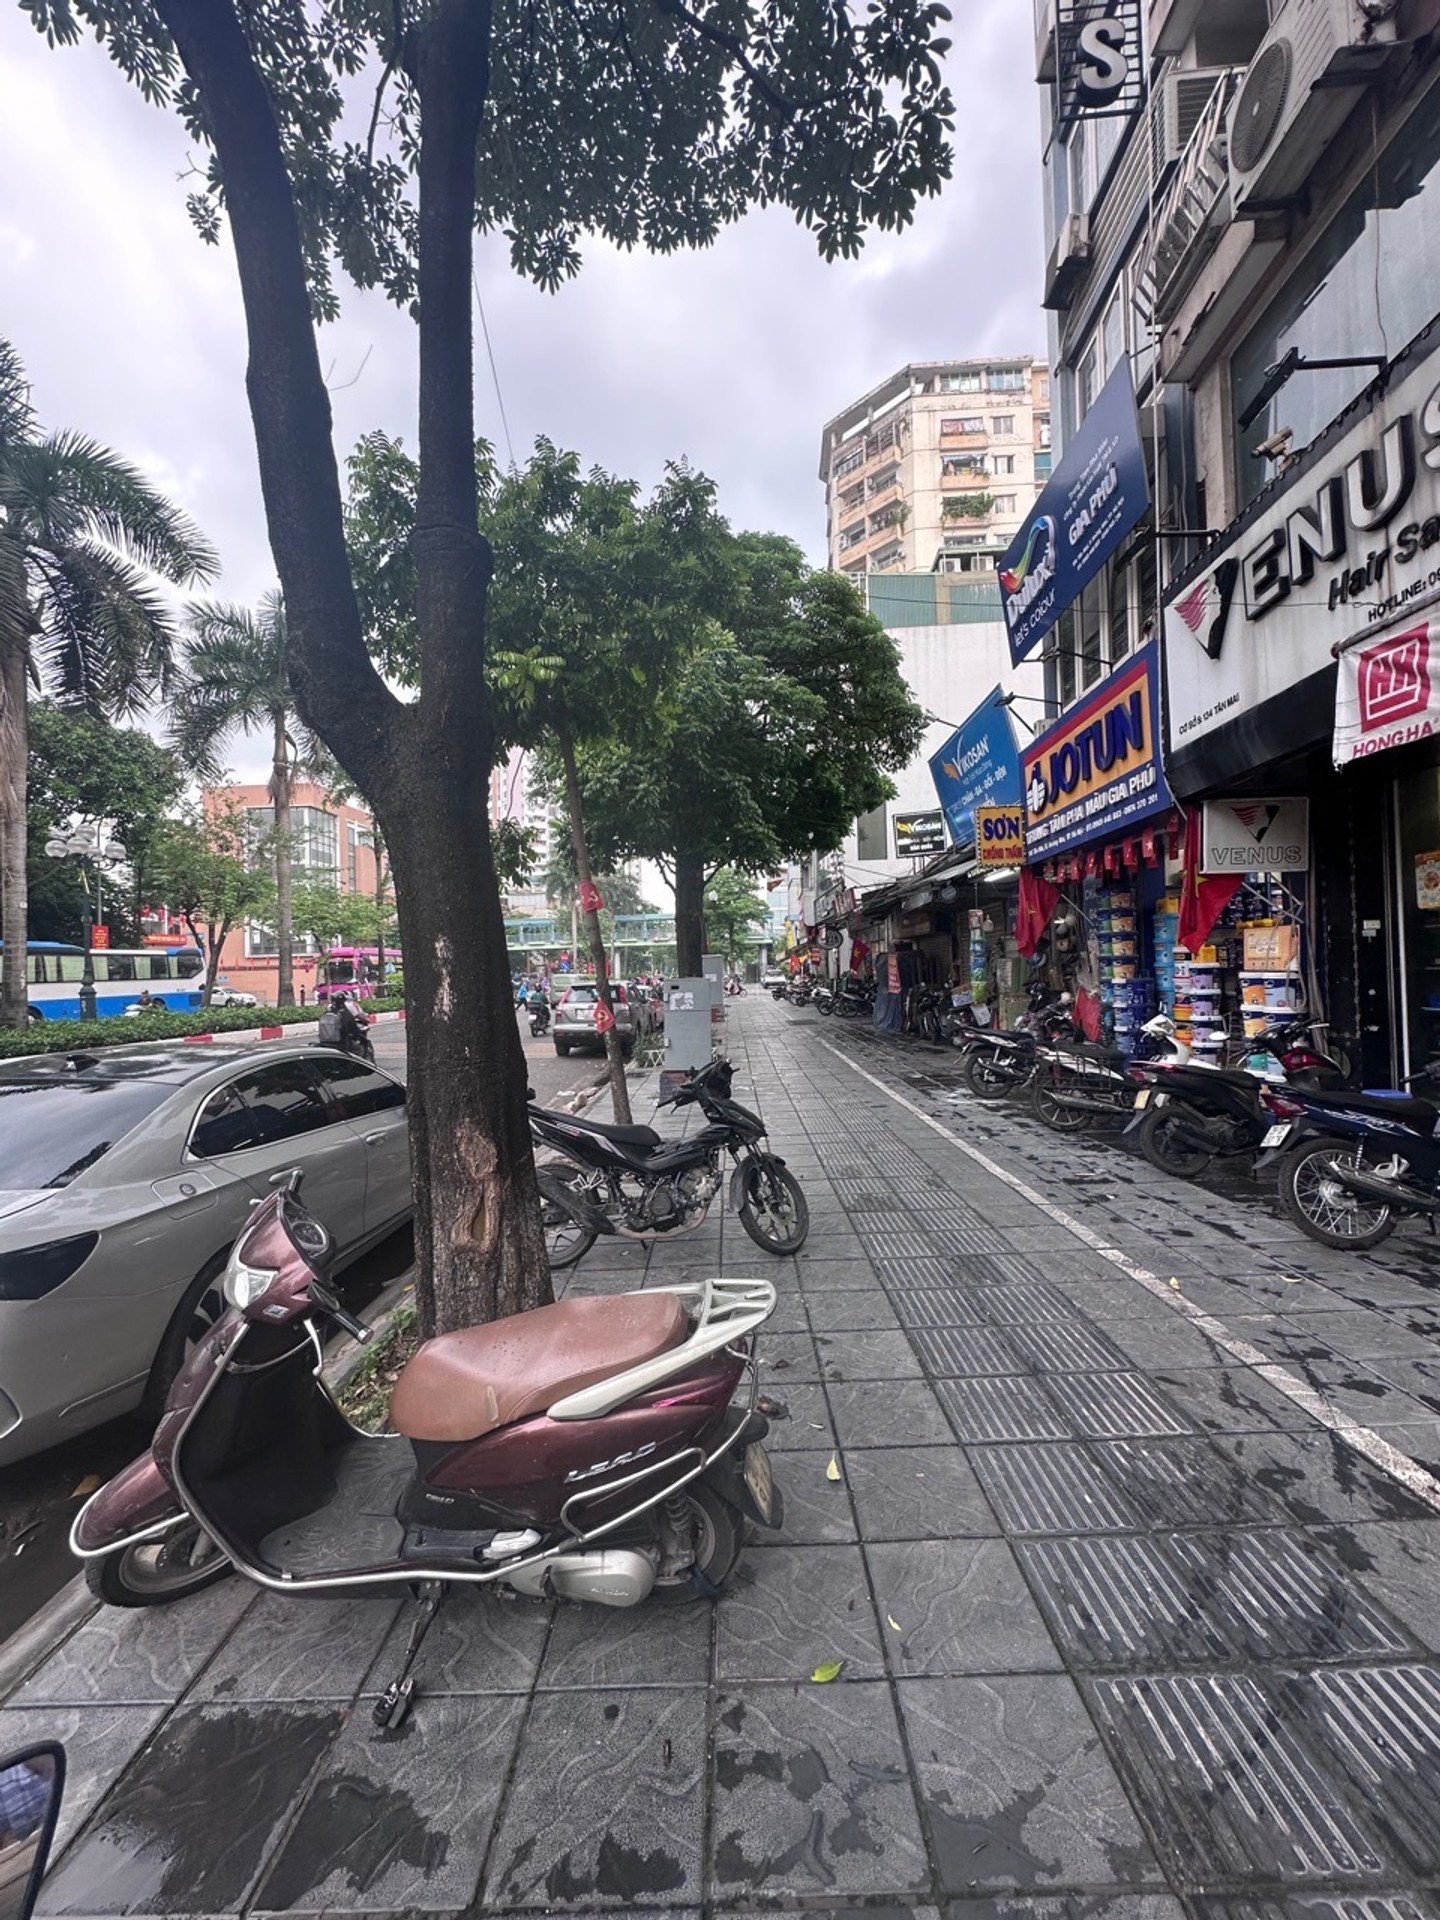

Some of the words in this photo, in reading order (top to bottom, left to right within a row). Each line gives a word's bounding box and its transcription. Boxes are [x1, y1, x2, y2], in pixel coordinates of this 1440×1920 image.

[1068, 507, 1092, 547] GIA
[1089, 462, 1118, 518] PHÚ
[1005, 542, 1055, 627] Dulux
[1327, 546, 1391, 611] Hair
[1368, 579, 1427, 623] HOTLINE:
[1047, 691, 1144, 804] JOTUN
[983, 813, 1020, 841] SƠN
[1048, 814, 1067, 834] TÂM
[1067, 806, 1084, 824] PHA
[1085, 791, 1109, 817] MÀU
[1108, 782, 1129, 806] GIA
[1129, 763, 1156, 795] PHÚ
[1211, 846, 1302, 866] VENUS
